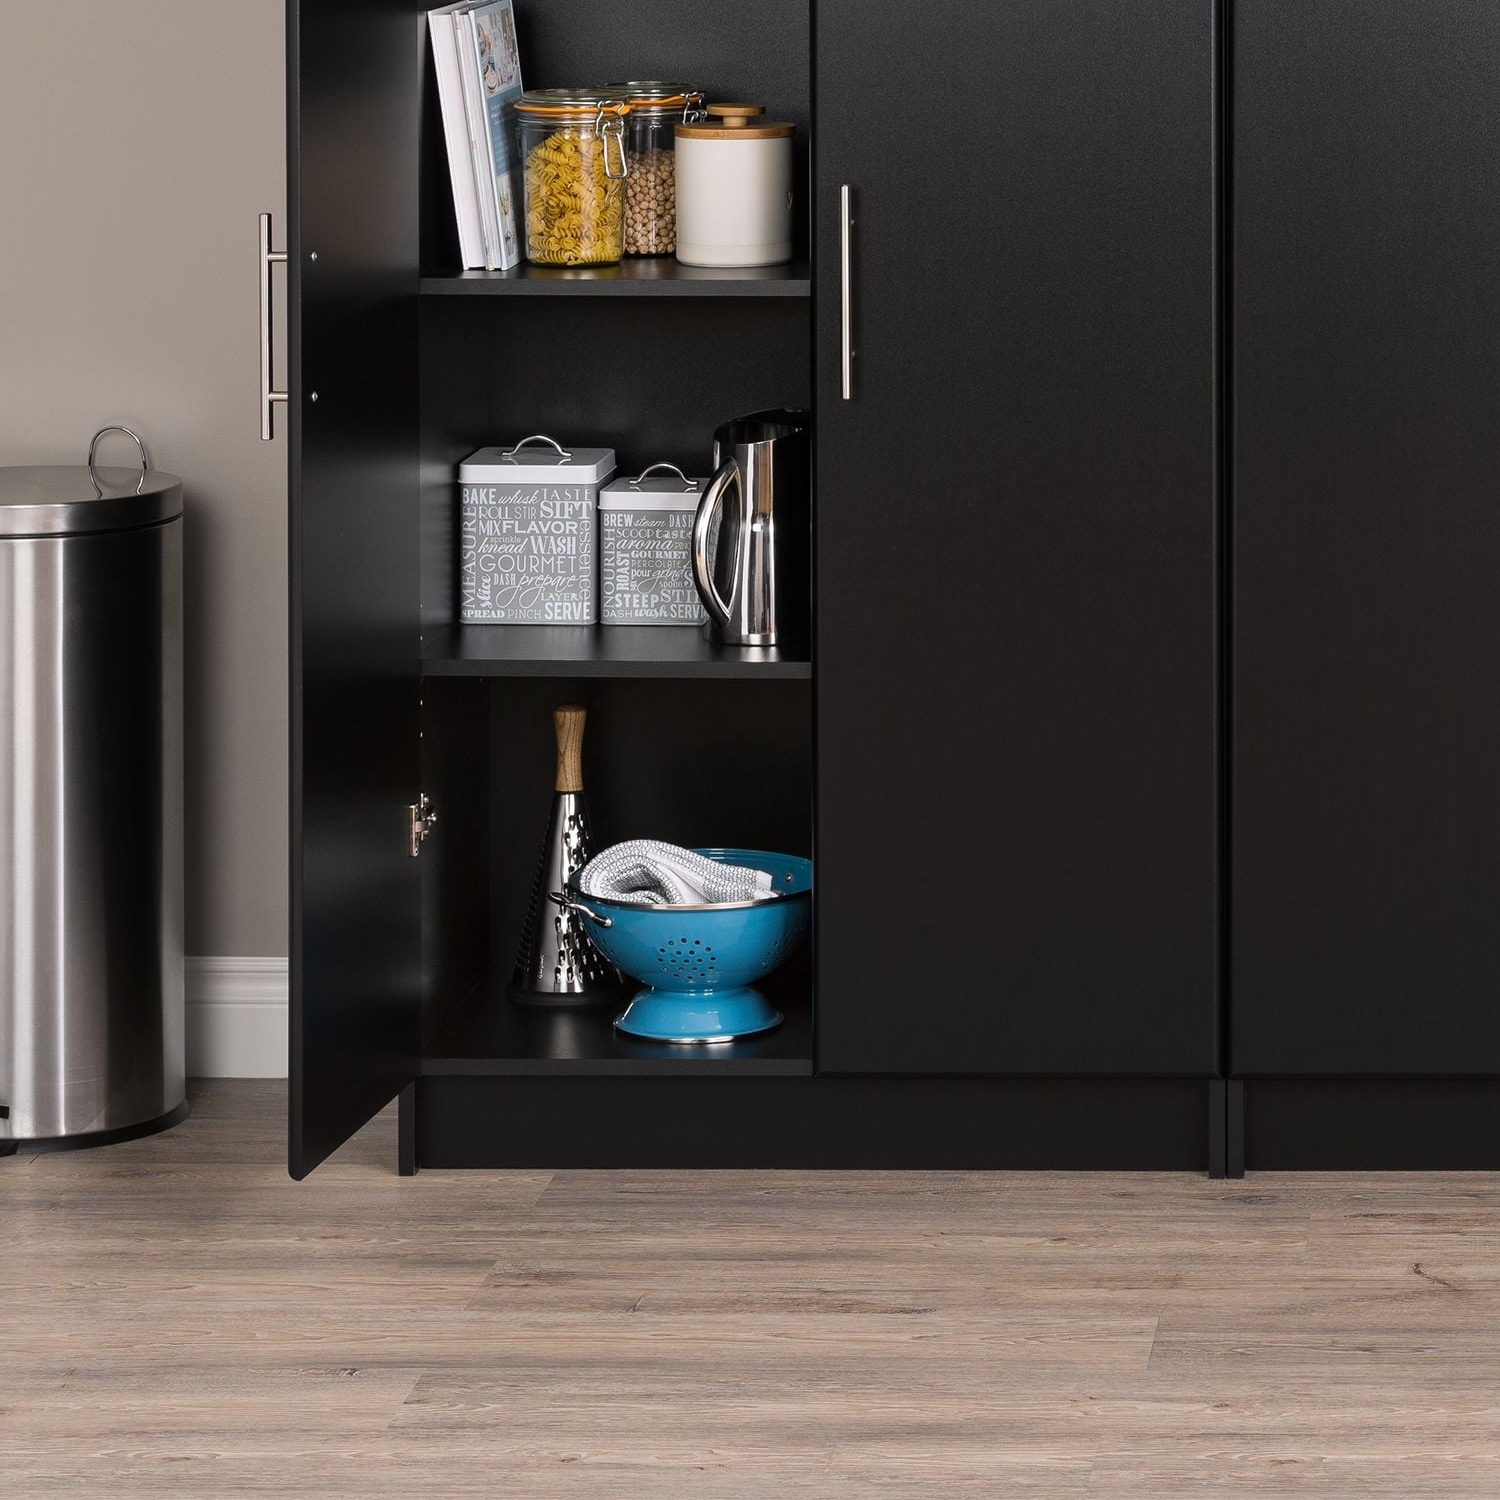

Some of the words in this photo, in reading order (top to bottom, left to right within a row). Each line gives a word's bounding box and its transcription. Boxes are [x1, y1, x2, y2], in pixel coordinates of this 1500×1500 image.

[463, 488, 496, 504] BAKE
[498, 490, 539, 504] whisk
[542, 489, 591, 500] TASTE
[479, 506, 512, 519] ROLL
[514, 506, 537, 519] STIR
[540, 500, 592, 519] SIFT
[479, 520, 501, 536] MIX
[503, 520, 578, 534] FLAVOR
[604, 514, 634, 527] BREW
[633, 515, 666, 527] steam
[616, 528, 654, 539] SCOOP
[478, 537, 529, 554] knead
[530, 536, 576, 555] WASH
[616, 539, 674, 550] aroma
[462, 506, 477, 609] MEASURE
[579, 520, 592, 600] essence
[631, 550, 688, 559] GOURMET
[479, 554, 576, 573] GOURMET
[603, 528, 615, 608] NOURISH
[616, 551, 629, 590] ROAST
[631, 560, 682, 568] PERCOLATE
[494, 573, 516, 585] DASH
[631, 569, 651, 579] pour
[637, 560, 691, 594] grind
[477, 574, 492, 609] slice
[496, 573, 579, 608] prepare
[541, 593, 579, 601] LAYER
[615, 594, 660, 608] STEEP
[462, 610, 505, 618] SPREAD
[508, 609, 542, 619] PINCH
[544, 602, 591, 620] SERVE
[603, 610, 632, 618] DASH
[635, 605, 669, 618] wash
